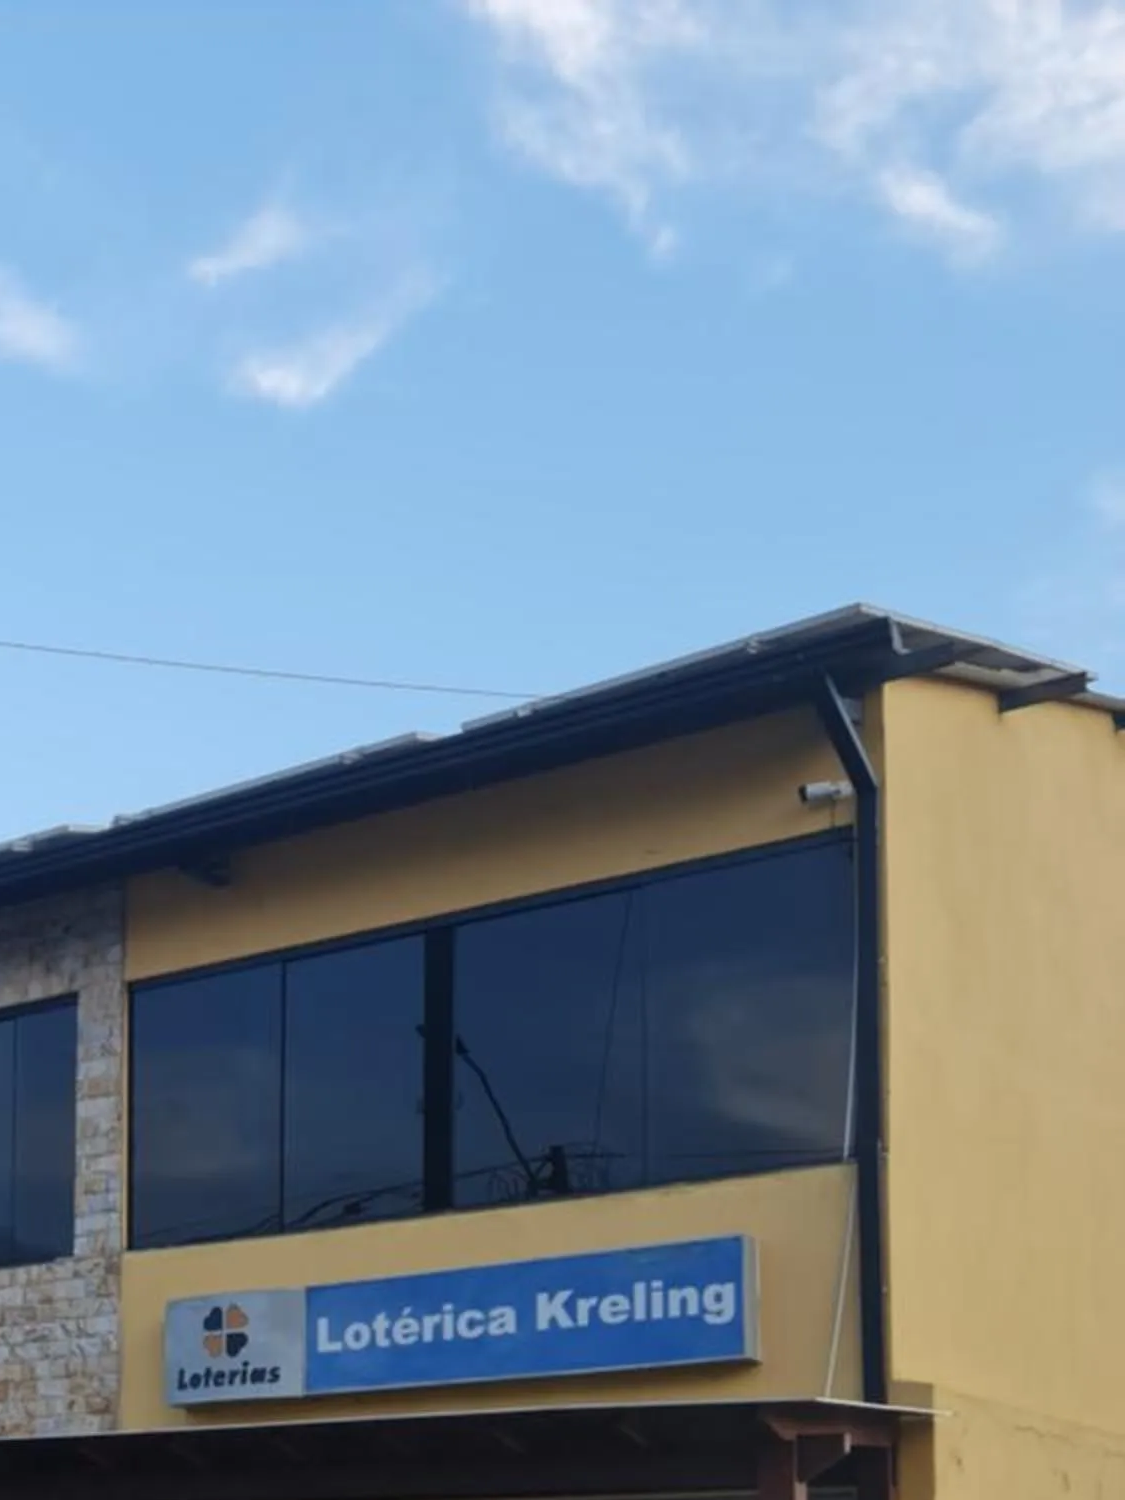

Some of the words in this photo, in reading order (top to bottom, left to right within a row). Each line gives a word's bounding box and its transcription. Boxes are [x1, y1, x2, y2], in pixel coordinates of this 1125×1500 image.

[316, 1305, 516, 1353] Lotérica
[535, 1280, 736, 1331] Kreling
[177, 1361, 281, 1391] Loterias
